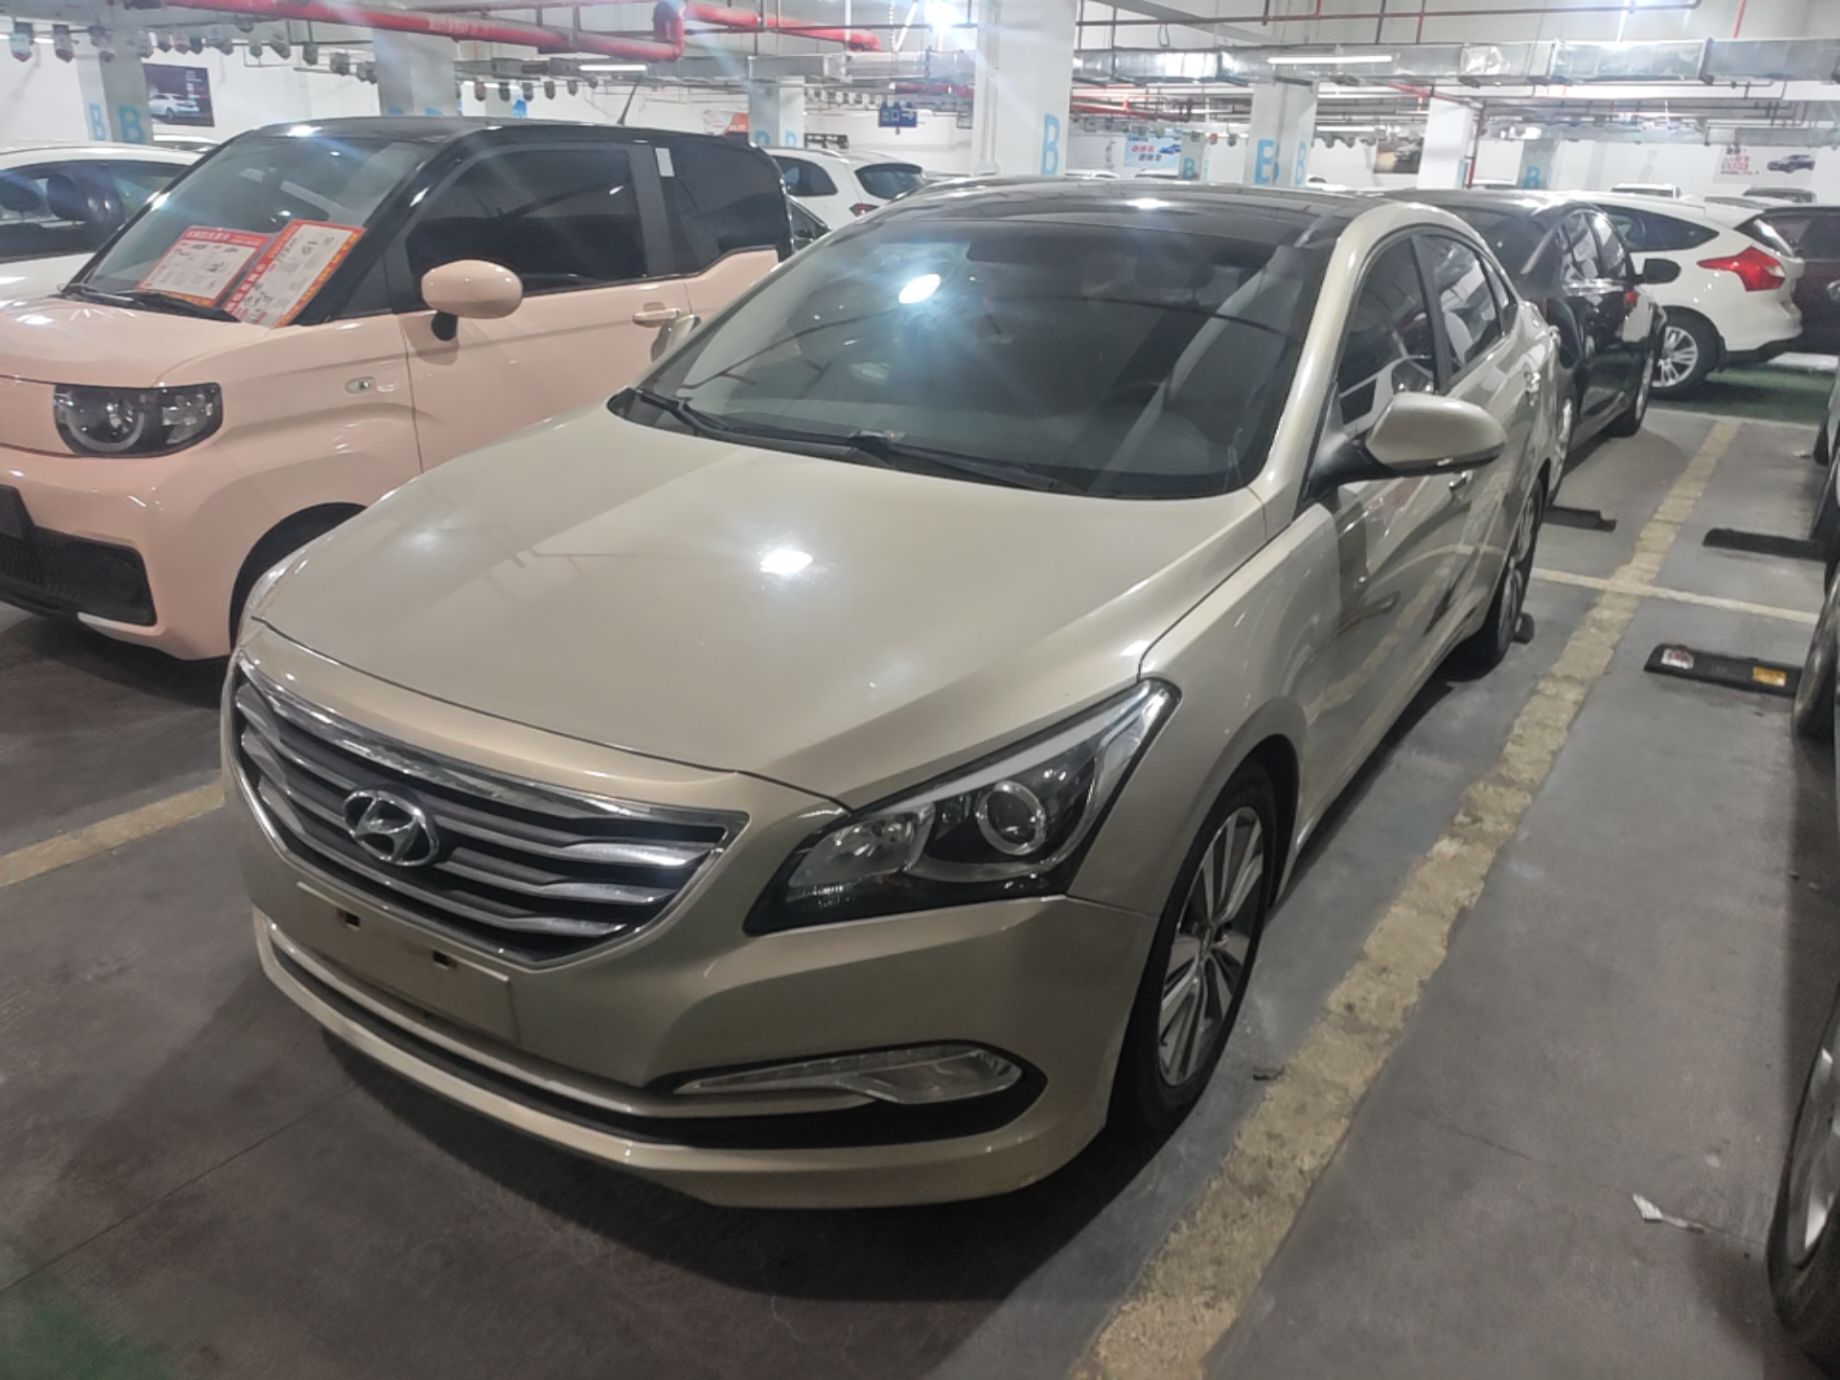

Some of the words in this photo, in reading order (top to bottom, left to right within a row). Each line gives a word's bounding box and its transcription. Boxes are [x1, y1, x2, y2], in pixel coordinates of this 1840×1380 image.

[118, 105, 146, 143] B
[1041, 113, 1060, 176] B
[1183, 158, 1196, 179] B
[1524, 166, 1540, 189] B
